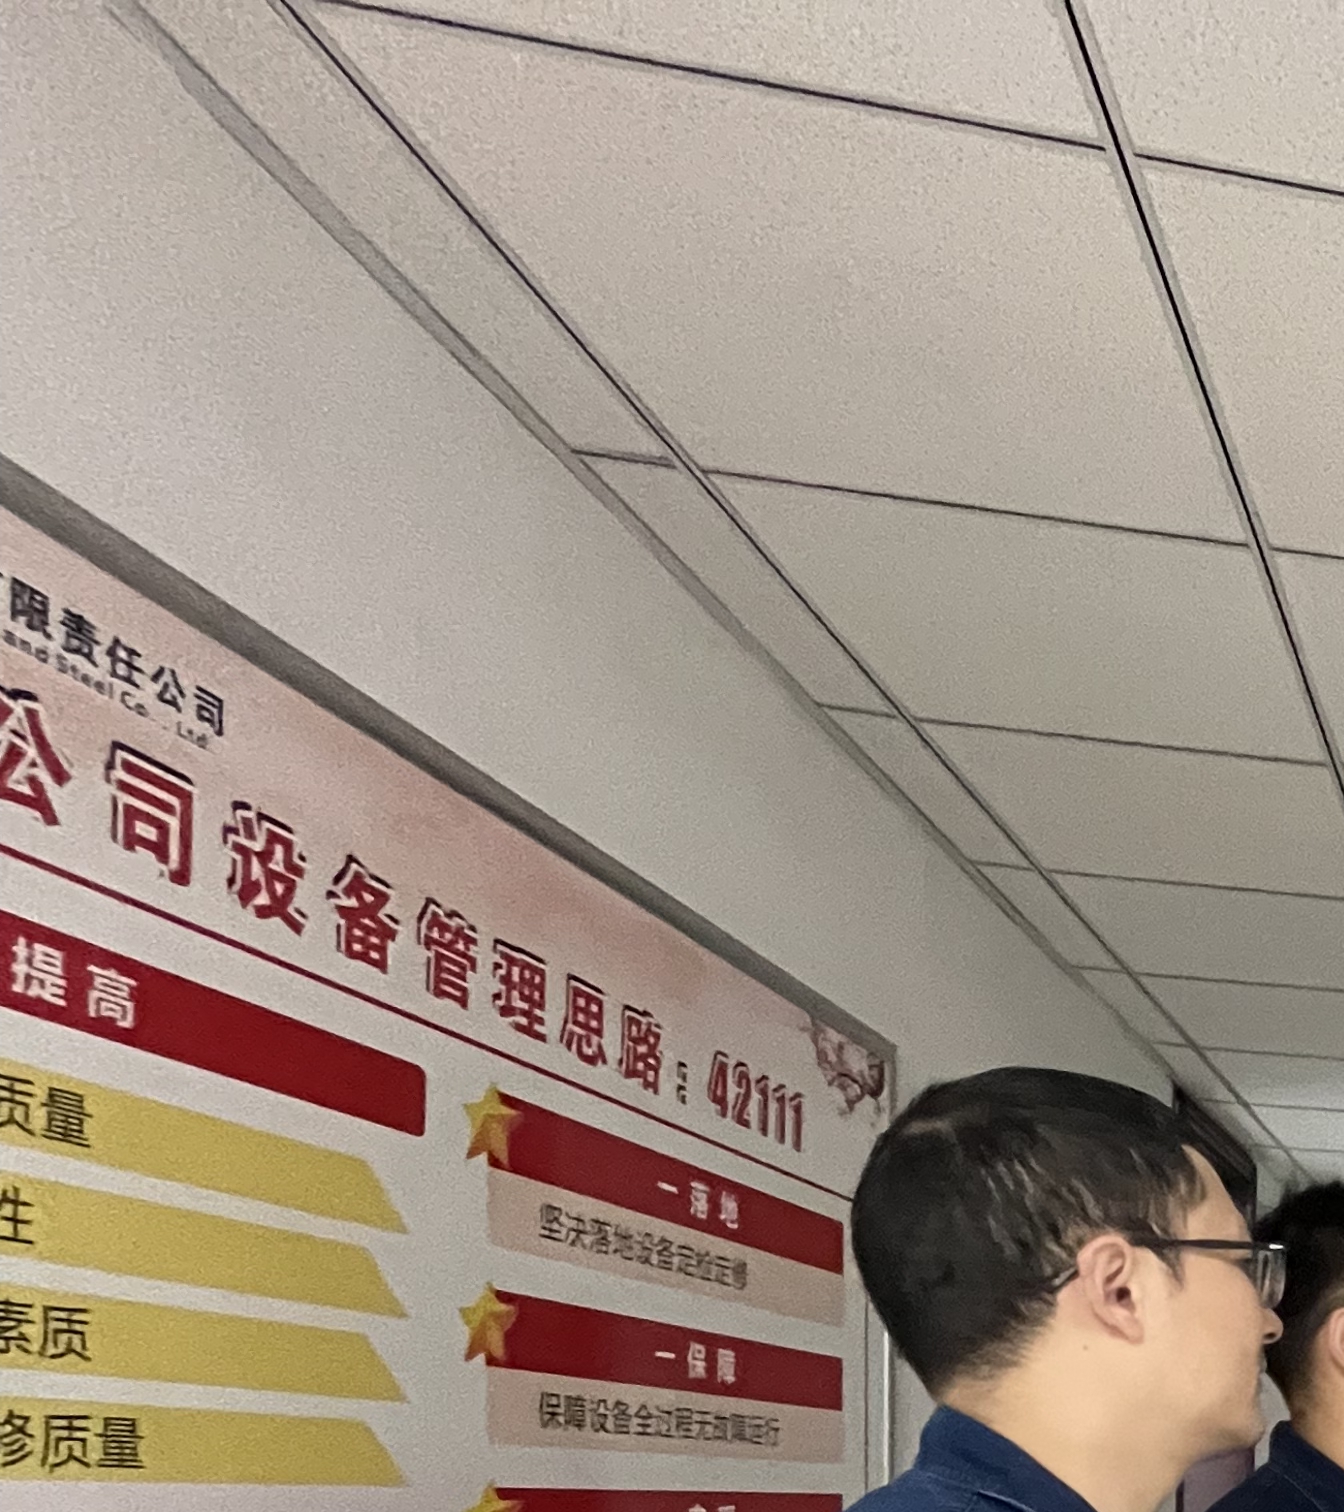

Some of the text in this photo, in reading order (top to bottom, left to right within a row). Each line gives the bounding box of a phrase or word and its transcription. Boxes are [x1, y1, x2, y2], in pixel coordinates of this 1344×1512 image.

[0, 573, 224, 737] 限责任公司
[11, 935, 138, 1029] 提高
